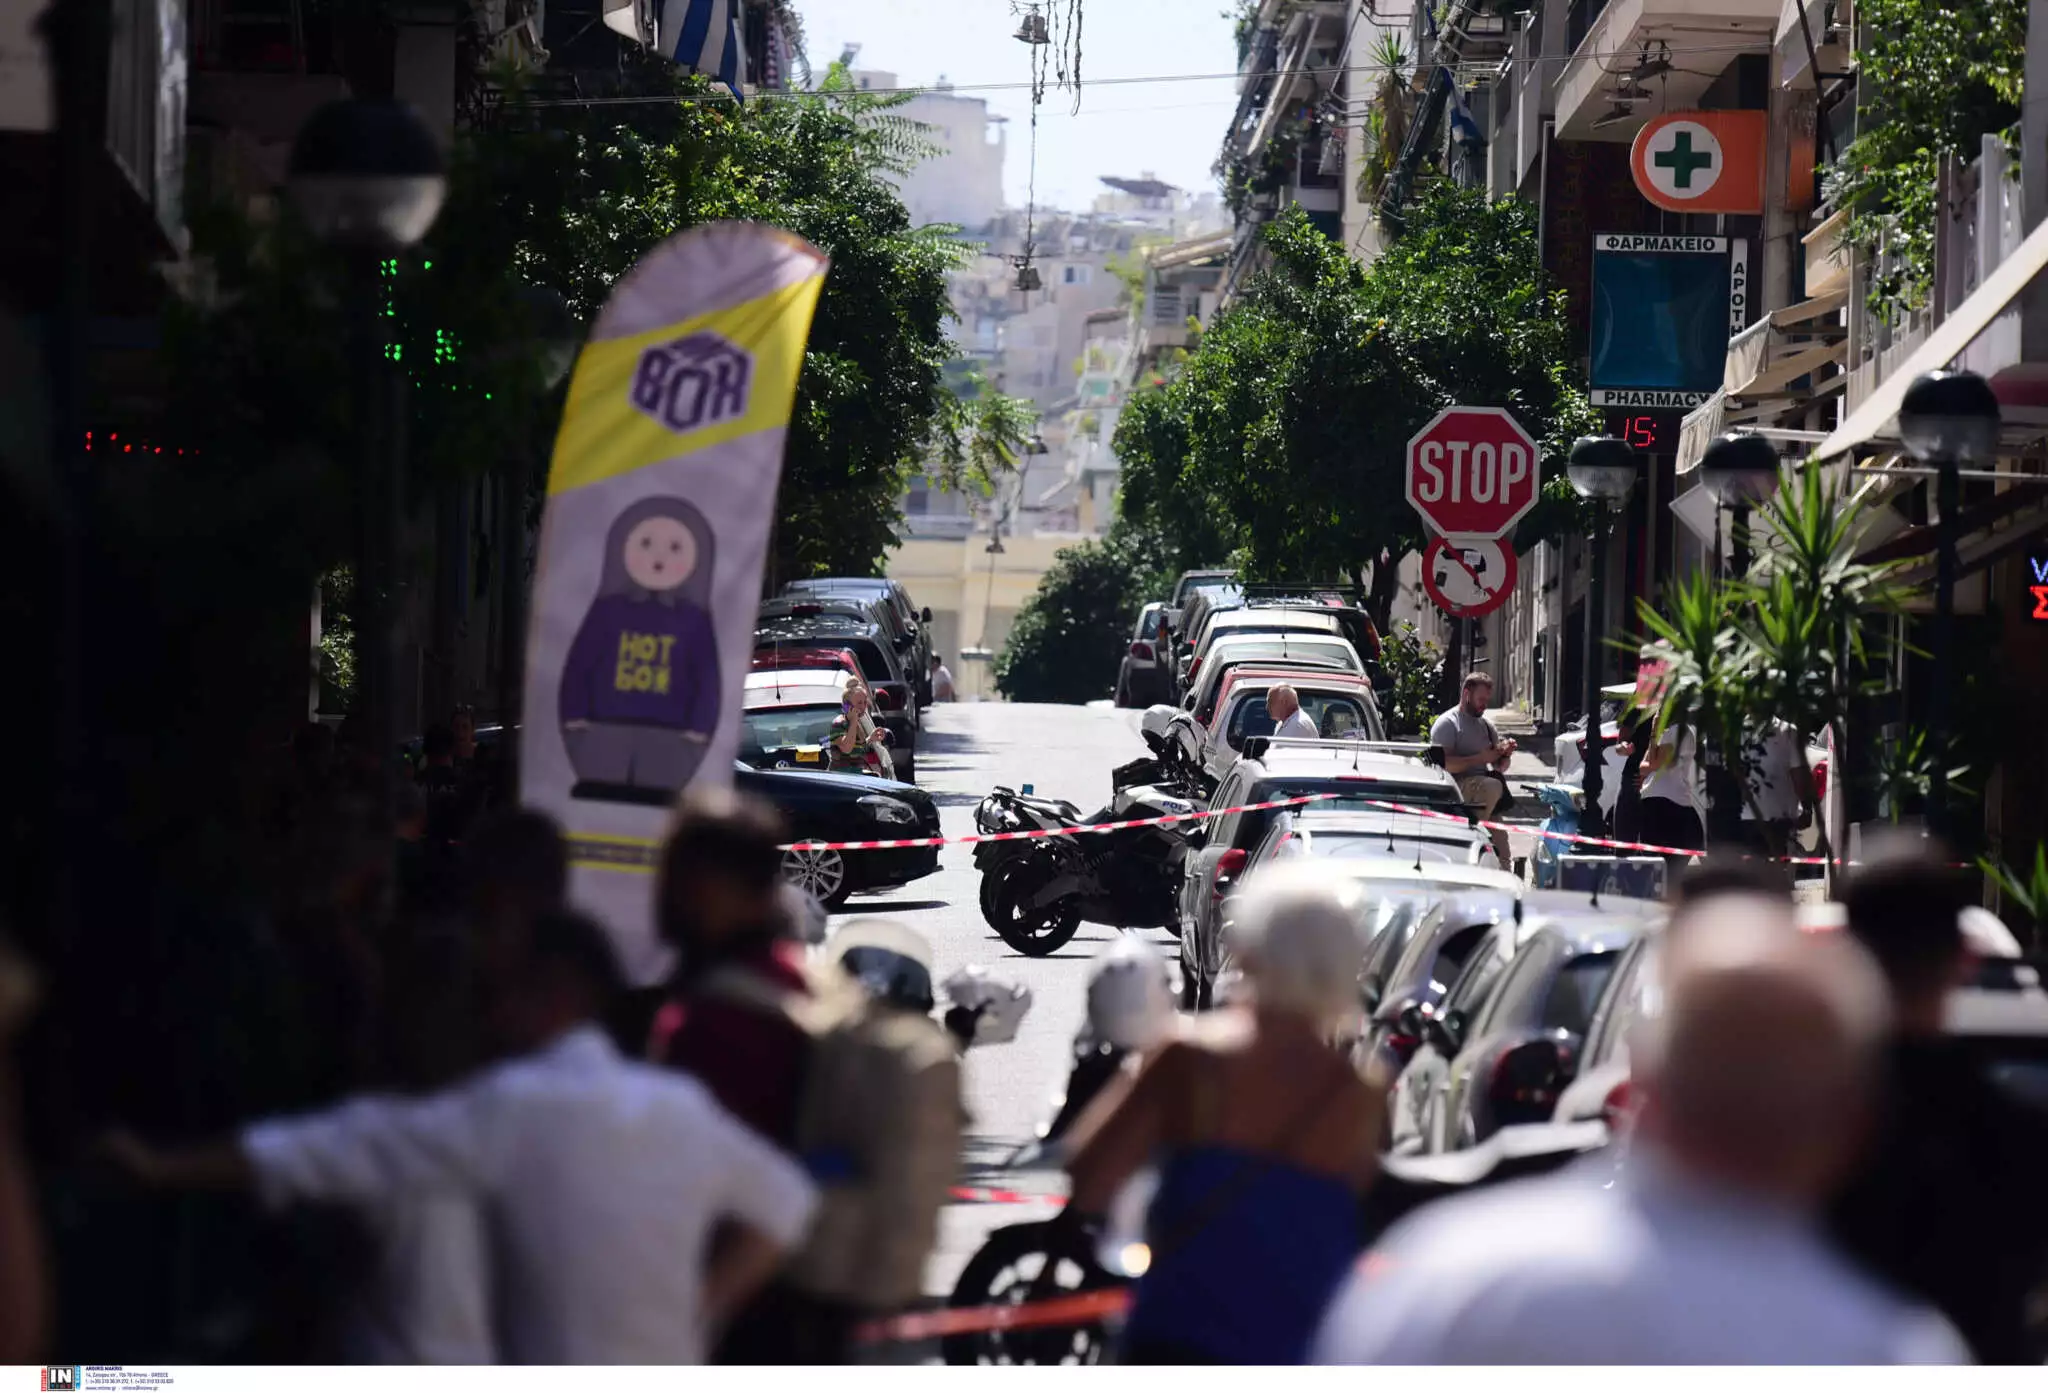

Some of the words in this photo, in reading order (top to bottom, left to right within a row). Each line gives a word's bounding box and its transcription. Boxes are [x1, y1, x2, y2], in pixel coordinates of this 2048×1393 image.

[1606, 236, 1715, 251] ΦΑΡΜΑΚΕΙΟ
[1604, 391, 1711, 407] PHARMACY
[1419, 441, 1527, 504] STOP
[619, 631, 677, 663] HOT
